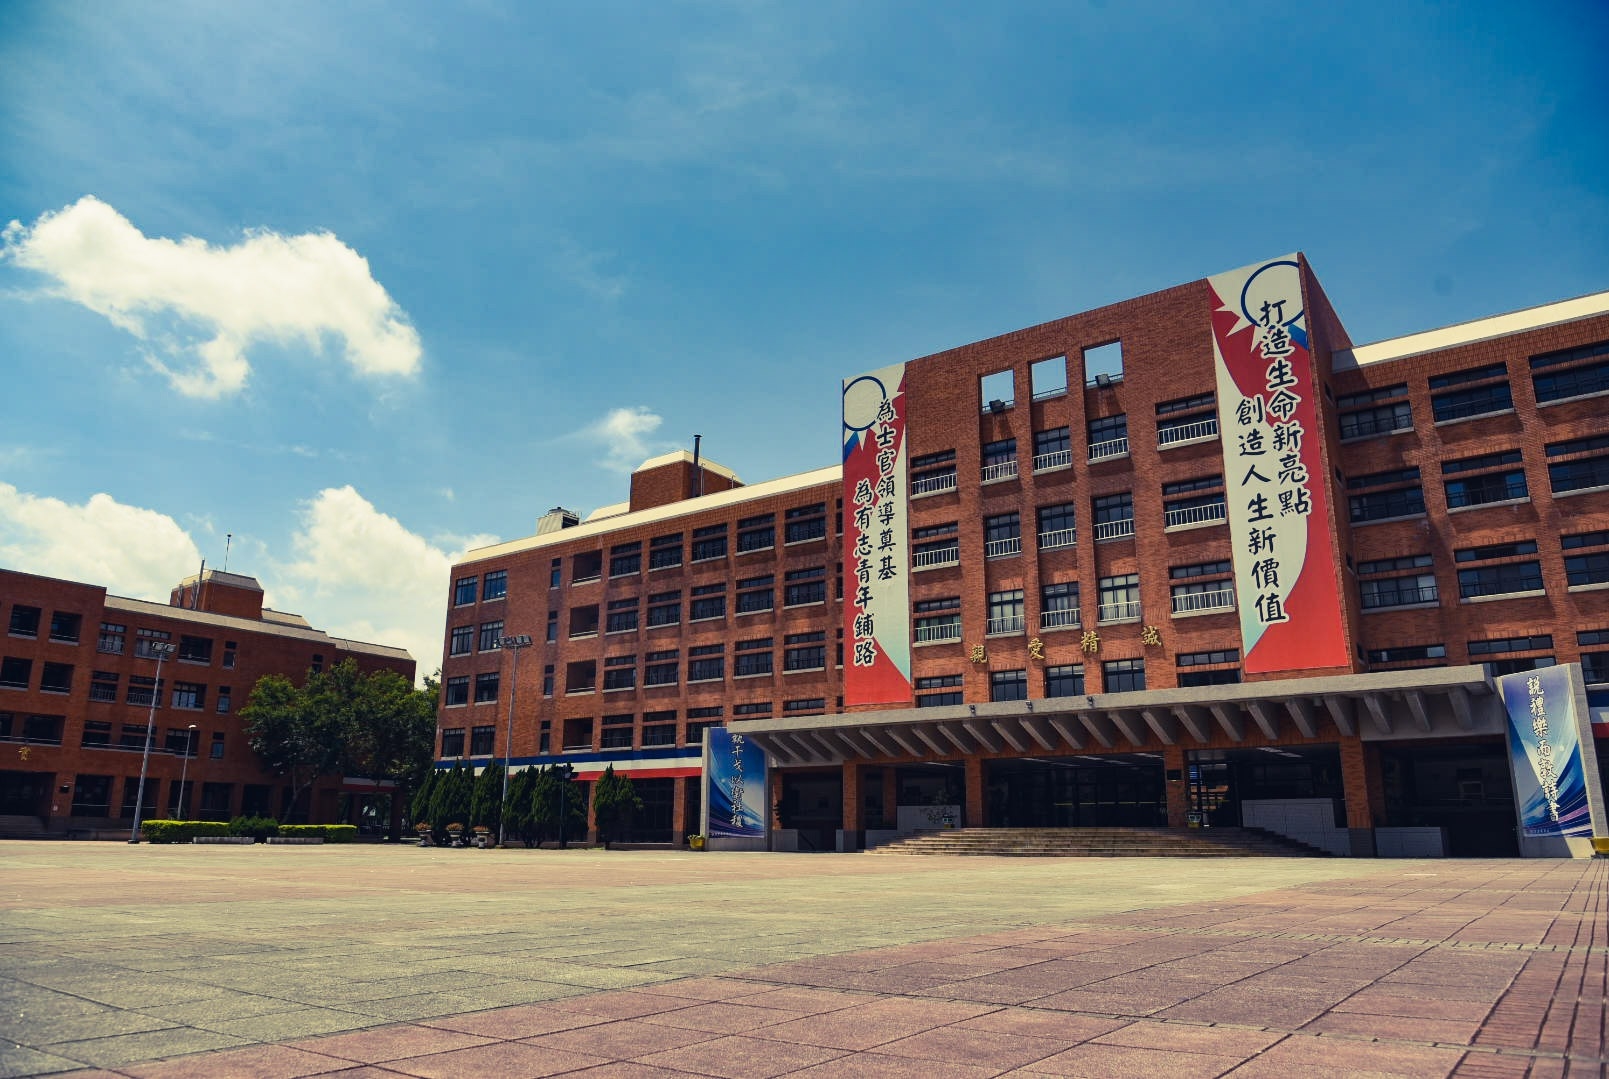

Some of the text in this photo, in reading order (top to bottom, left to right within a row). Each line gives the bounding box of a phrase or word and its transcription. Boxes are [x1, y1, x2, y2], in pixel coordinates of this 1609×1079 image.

[876, 398, 897, 581] 為士官領導奠基
[1259, 299, 1309, 518] 打造生命新亮點
[855, 479, 875, 666] 為有志青年鋪路
[1236, 396, 1287, 623] 創造人生新價值
[970, 626, 1162, 664] 親愛精誠
